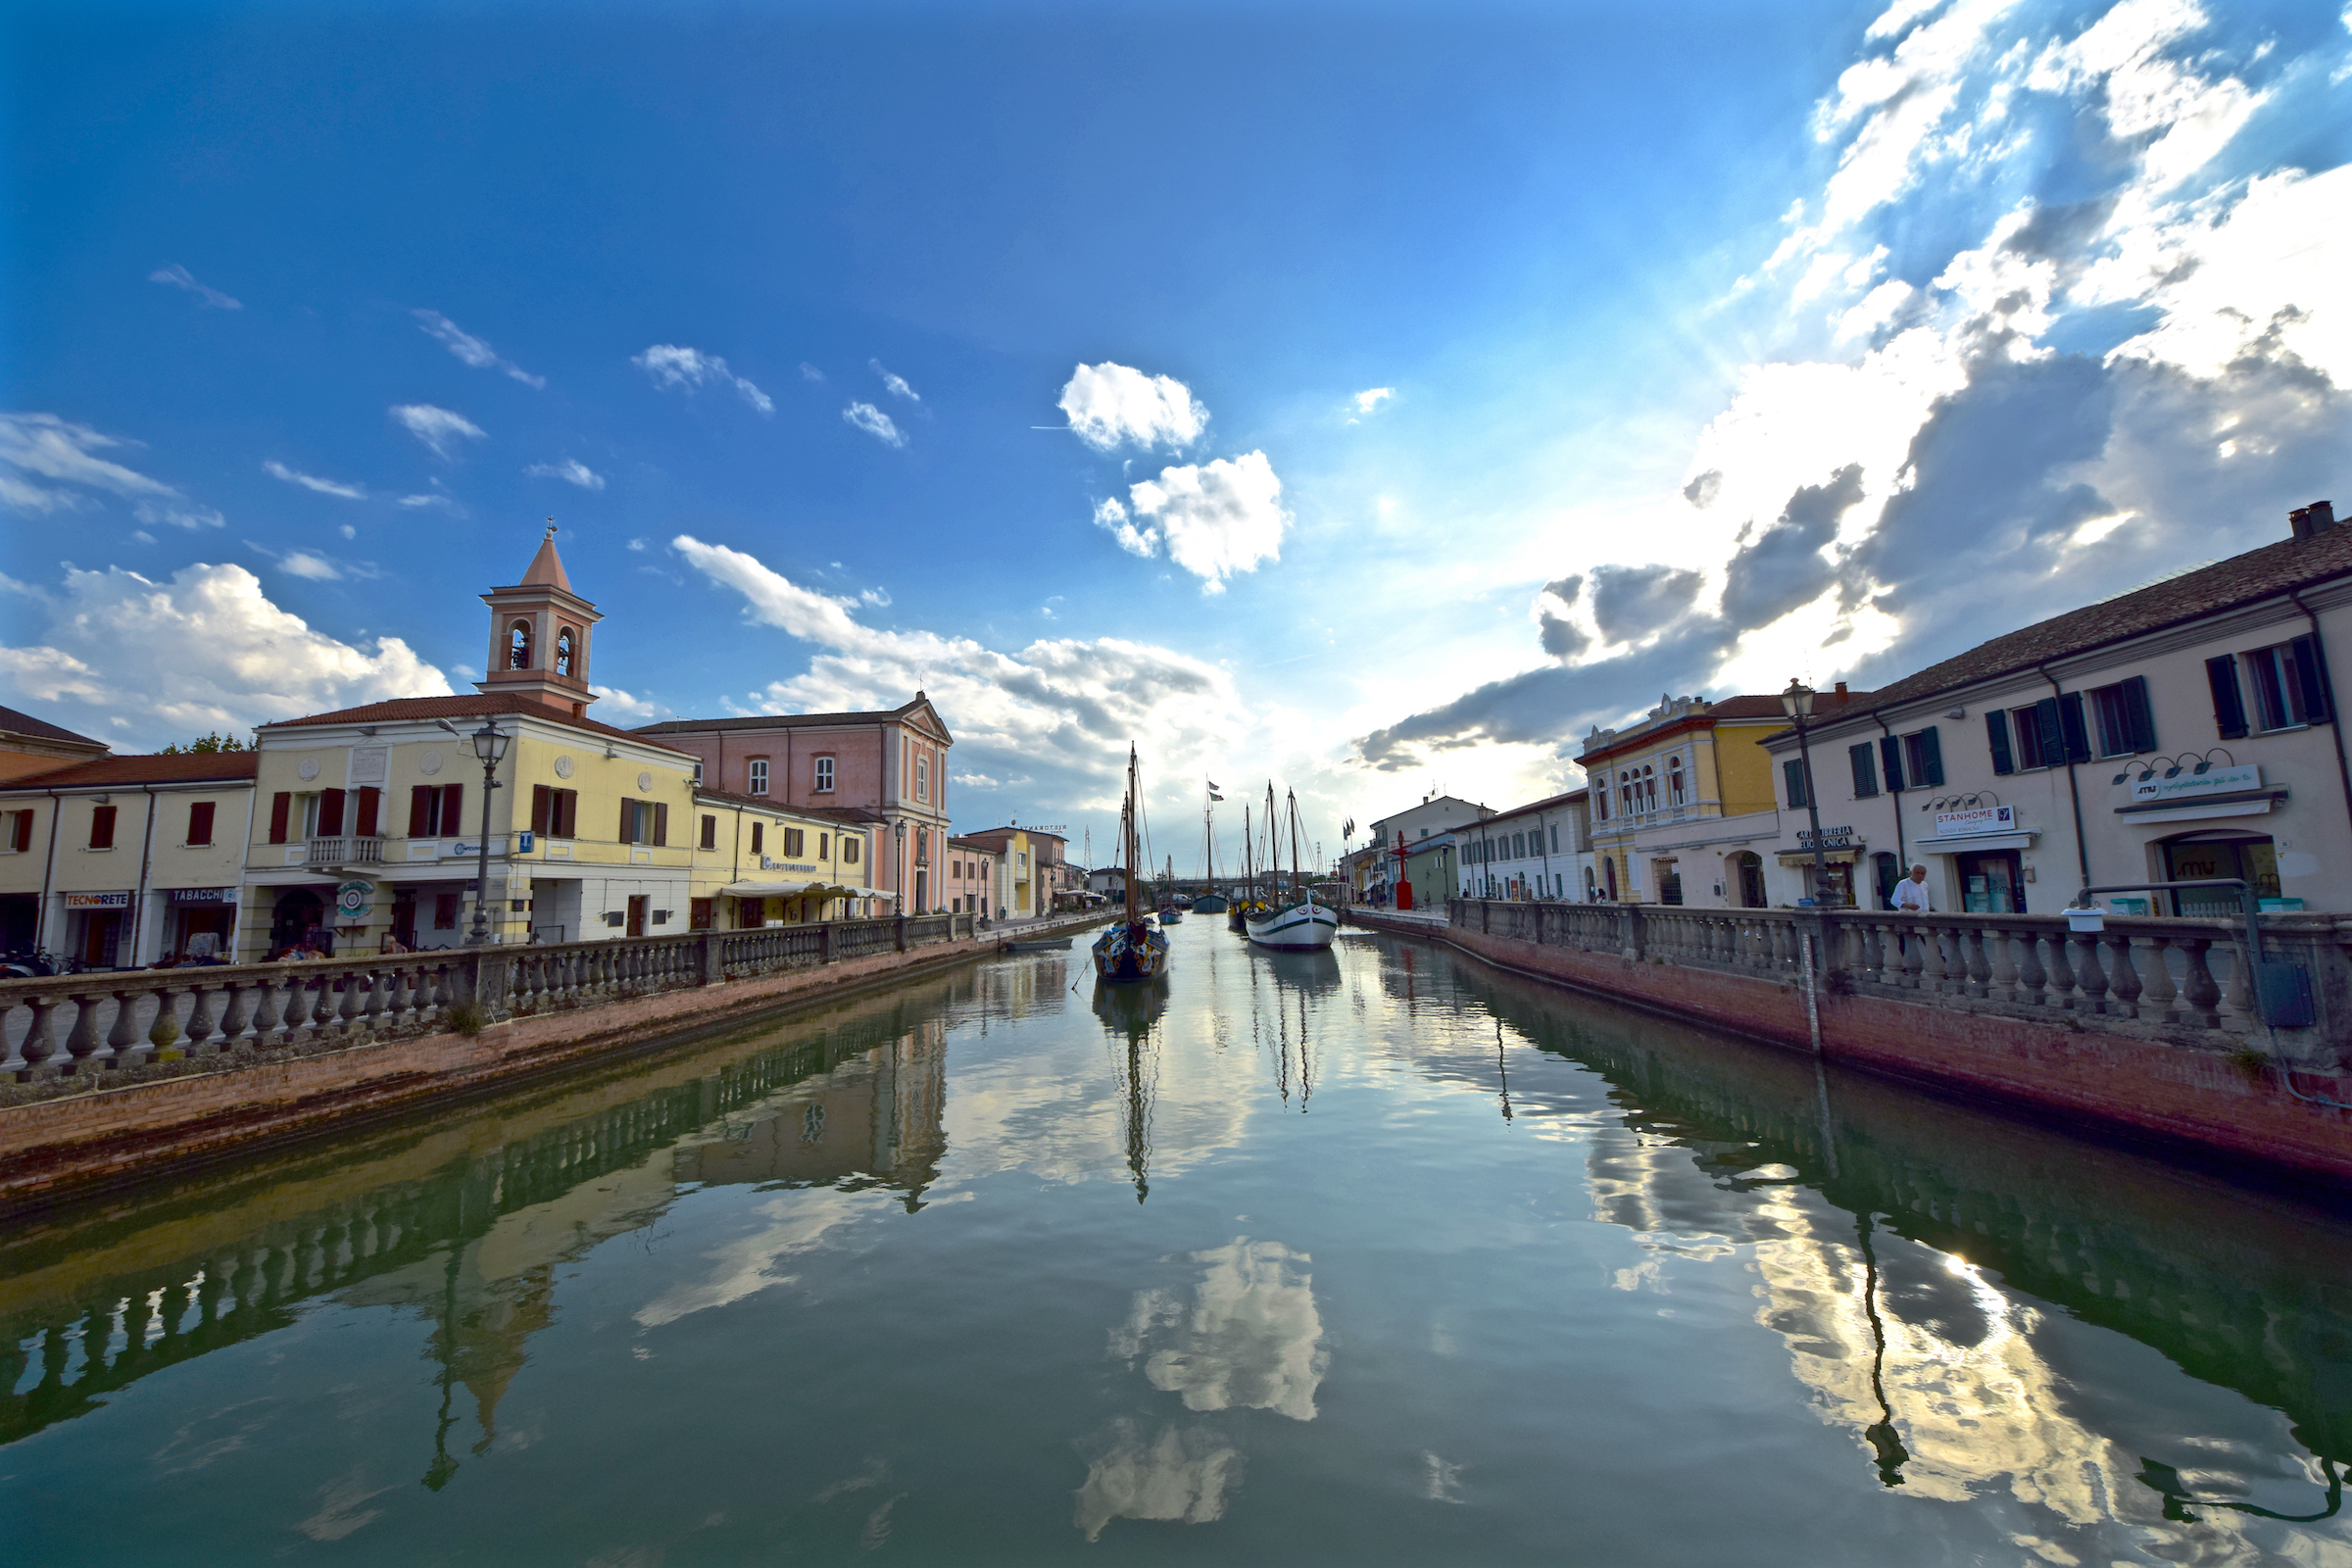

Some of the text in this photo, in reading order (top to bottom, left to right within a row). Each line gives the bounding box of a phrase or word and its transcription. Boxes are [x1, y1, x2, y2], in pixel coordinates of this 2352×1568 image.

[1937, 809, 1993, 823] STANHOME
[1797, 826, 1850, 839] CARTIBRERIA
[1801, 837, 1847, 849] ELIOCNICA
[68, 894, 127, 906] TECNORETE
[174, 889, 223, 901] TABACCHI
